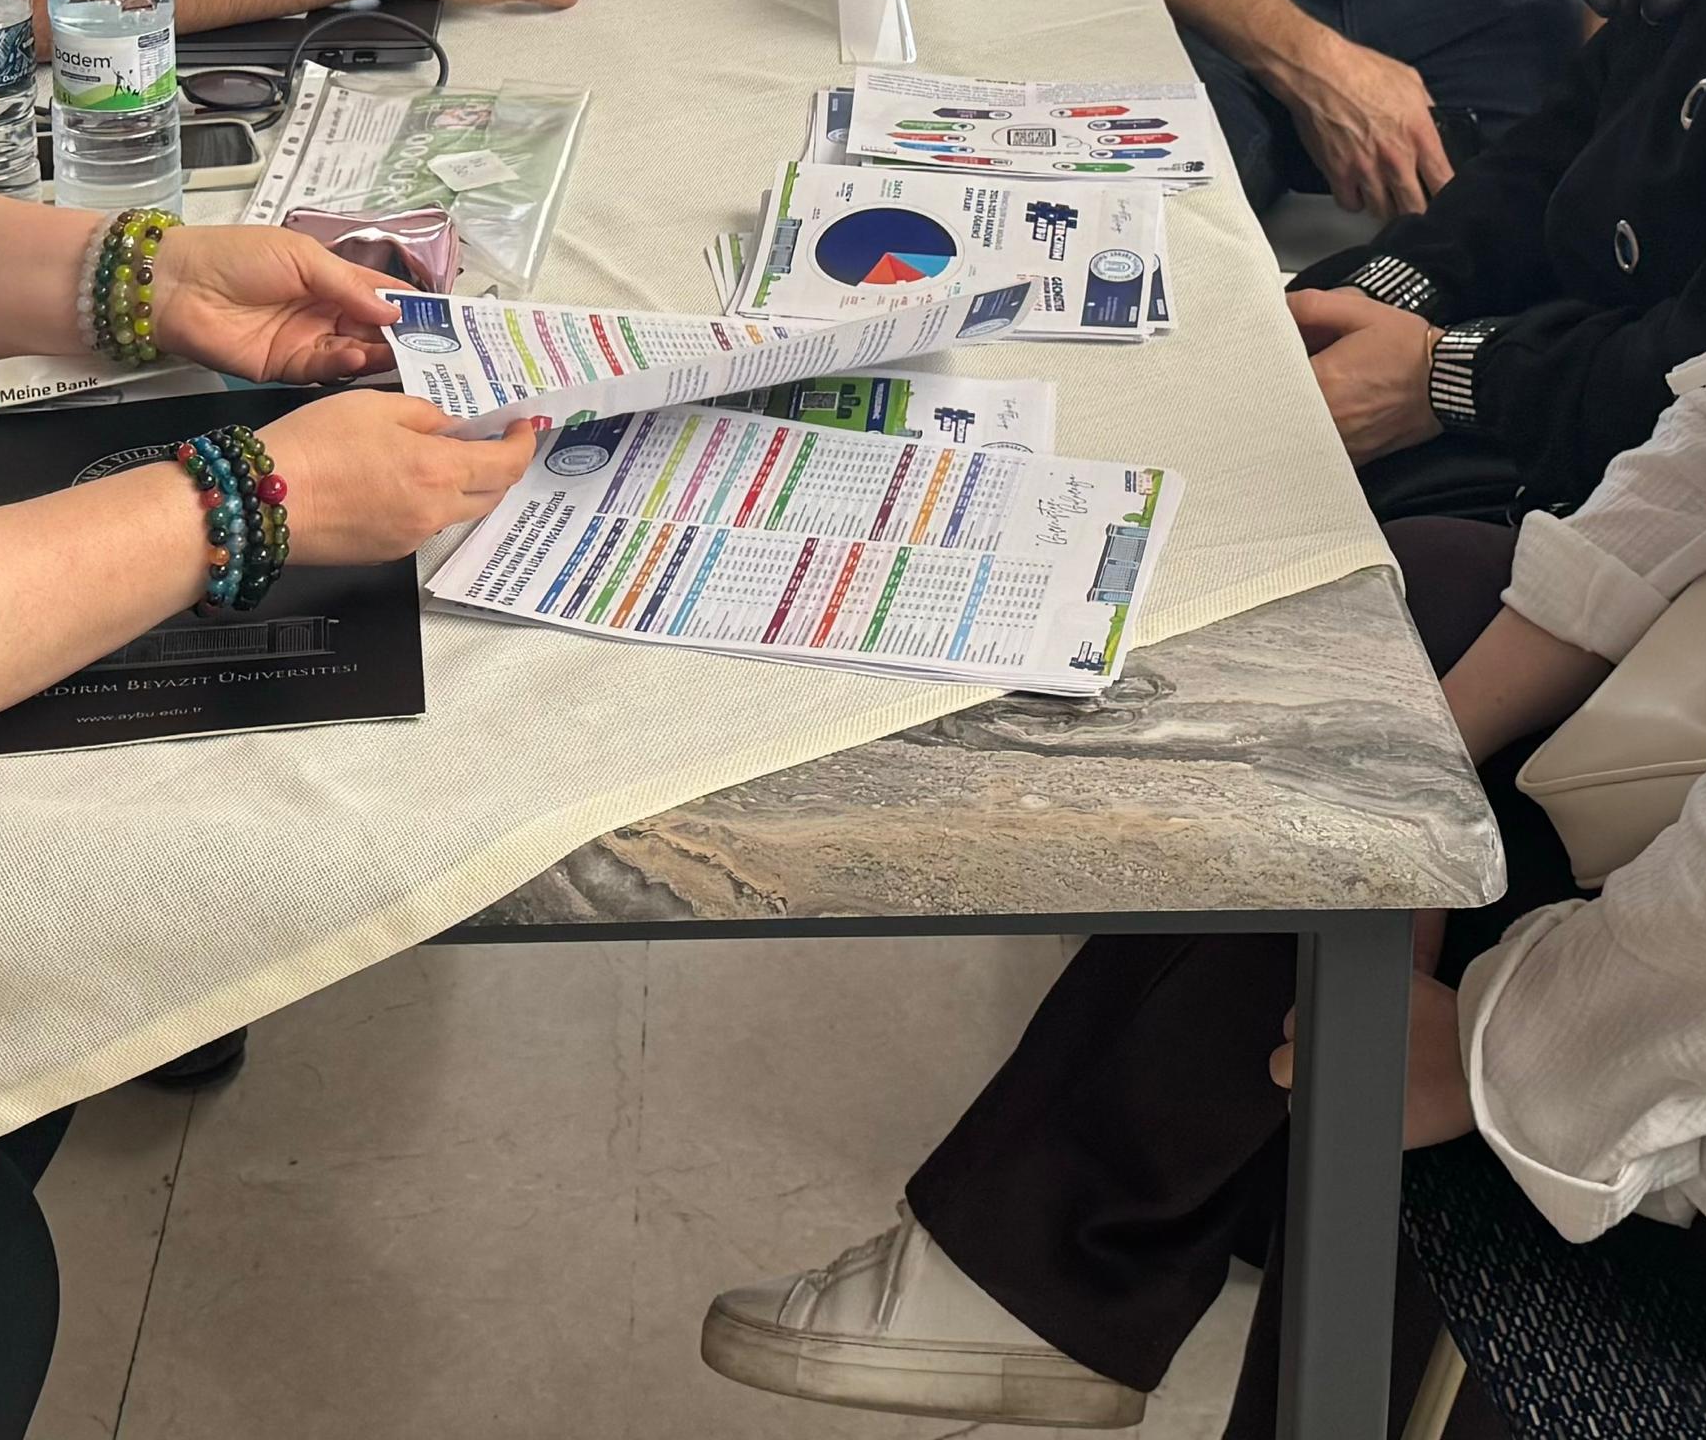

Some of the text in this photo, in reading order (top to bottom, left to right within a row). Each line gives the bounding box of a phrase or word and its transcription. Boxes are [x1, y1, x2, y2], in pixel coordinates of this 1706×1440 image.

[55, 45, 110, 68] badem
[0, 377, 98, 403] Meine Bank
[36, 682, 118, 699] LDIRIM
[127, 674, 211, 691] BEYAZIT
